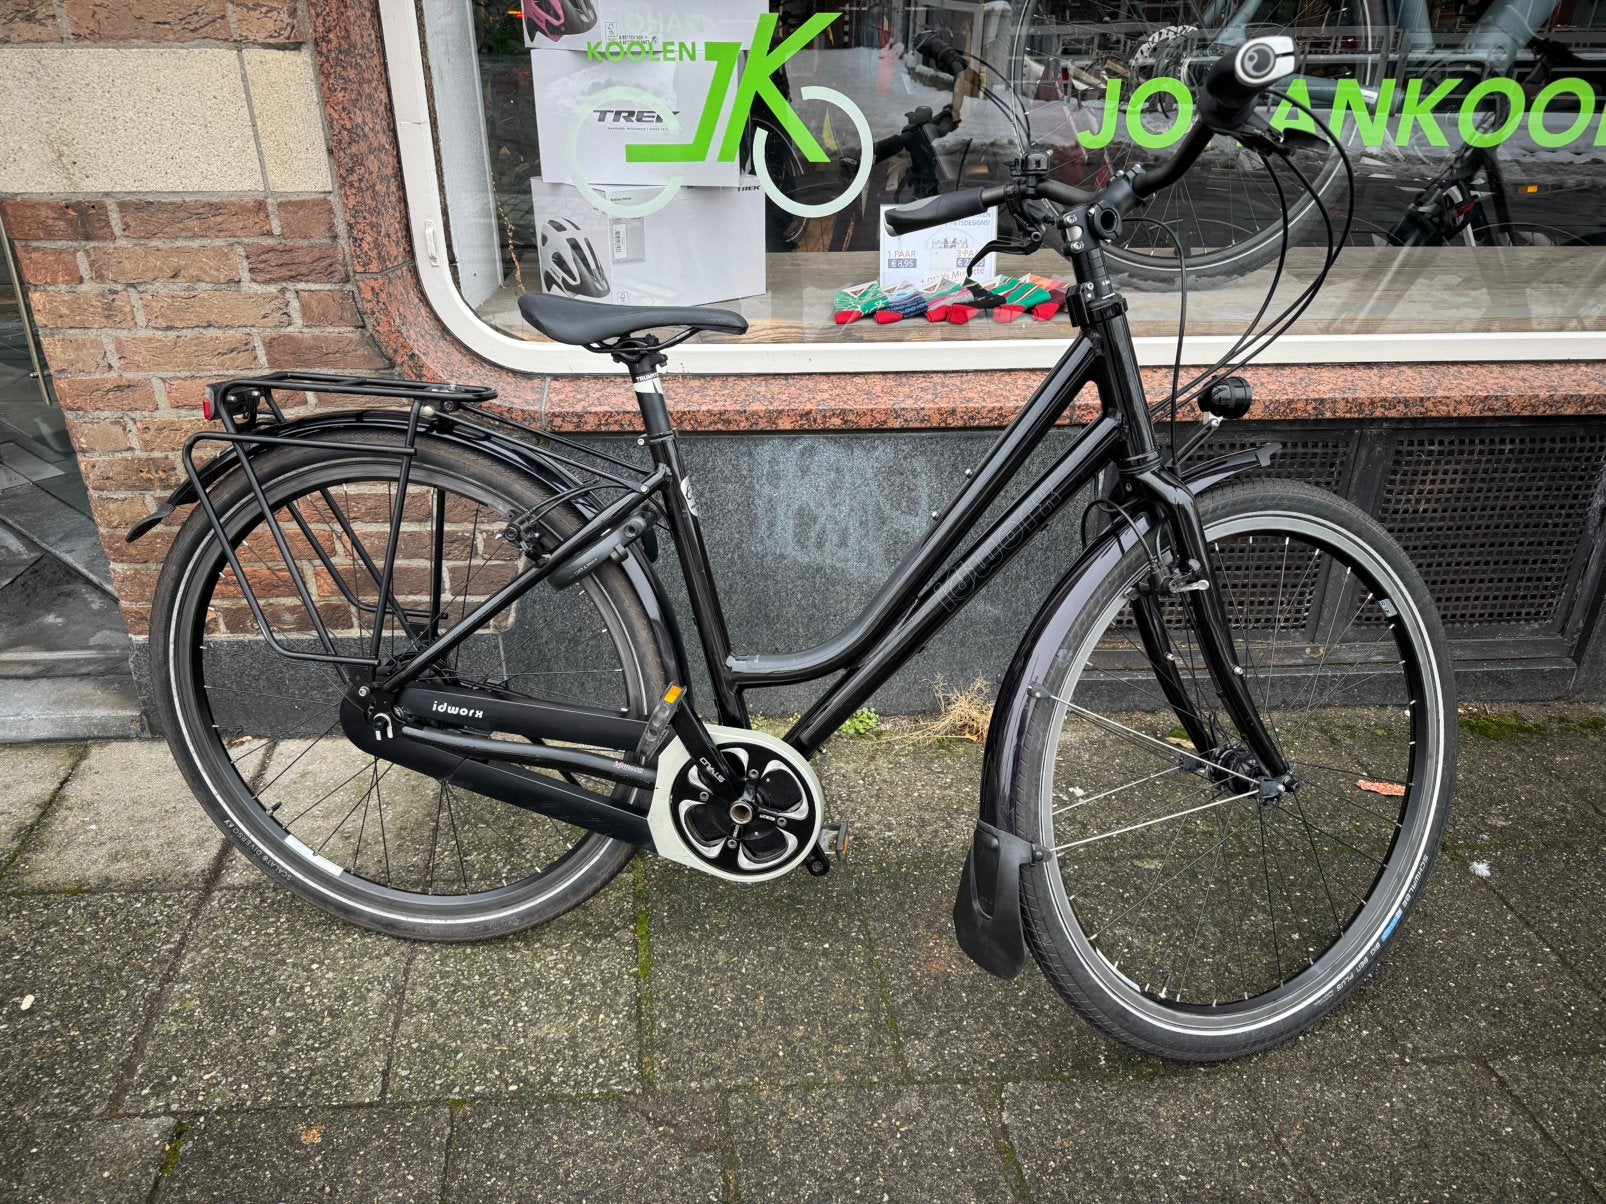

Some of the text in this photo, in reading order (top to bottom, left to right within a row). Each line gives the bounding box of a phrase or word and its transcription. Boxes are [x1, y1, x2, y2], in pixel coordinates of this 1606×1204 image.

[587, 41, 697, 62] KOOLEN
[1076, 77, 1606, 149] JOANKOO
[894, 250, 916, 258] PAAR
[432, 700, 484, 719] idworx
[232, 827, 292, 881] SCALATO DIVERSO
[1401, 854, 1429, 908] SCHWALBE
[1370, 941, 1381, 957] BIG
[1336, 974, 1355, 992] PLUS
